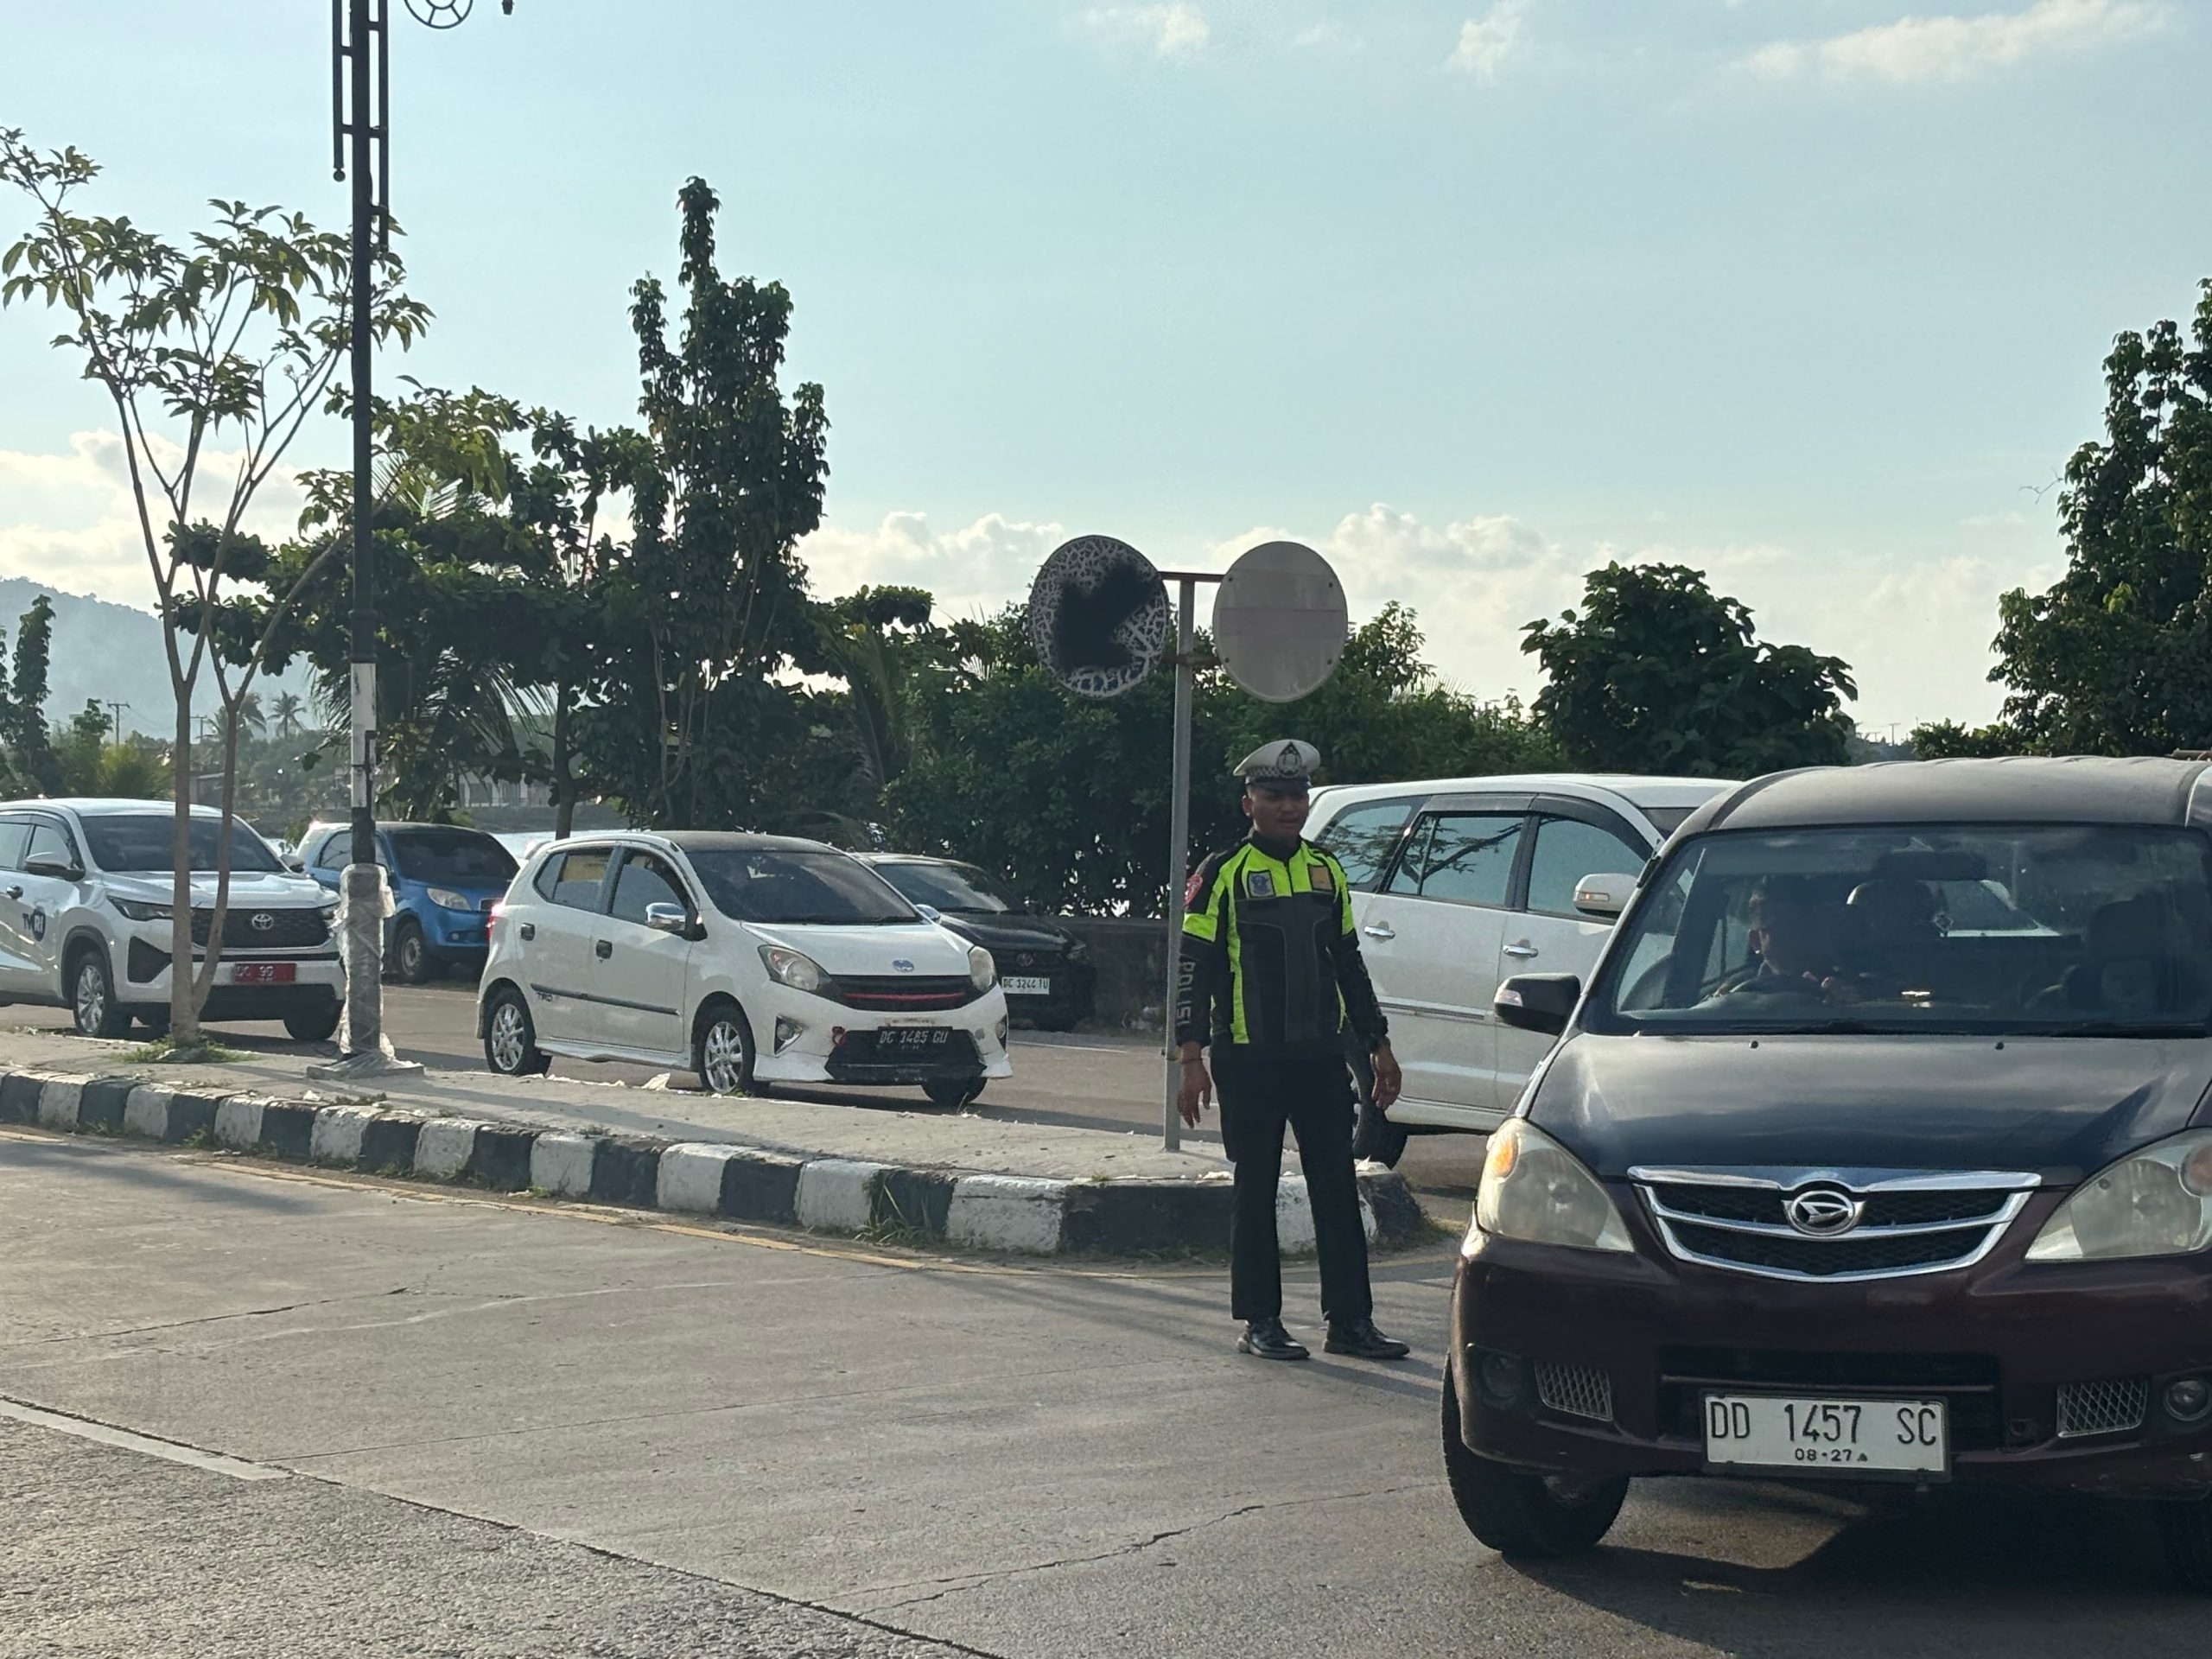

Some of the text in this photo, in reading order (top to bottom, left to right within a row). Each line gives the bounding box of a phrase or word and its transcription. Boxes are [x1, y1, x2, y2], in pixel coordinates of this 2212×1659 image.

[1177, 962, 1196, 1026] POLISI
[880, 1031, 895, 1044] DC
[1710, 1401, 1936, 1446] DD 1457 SC
